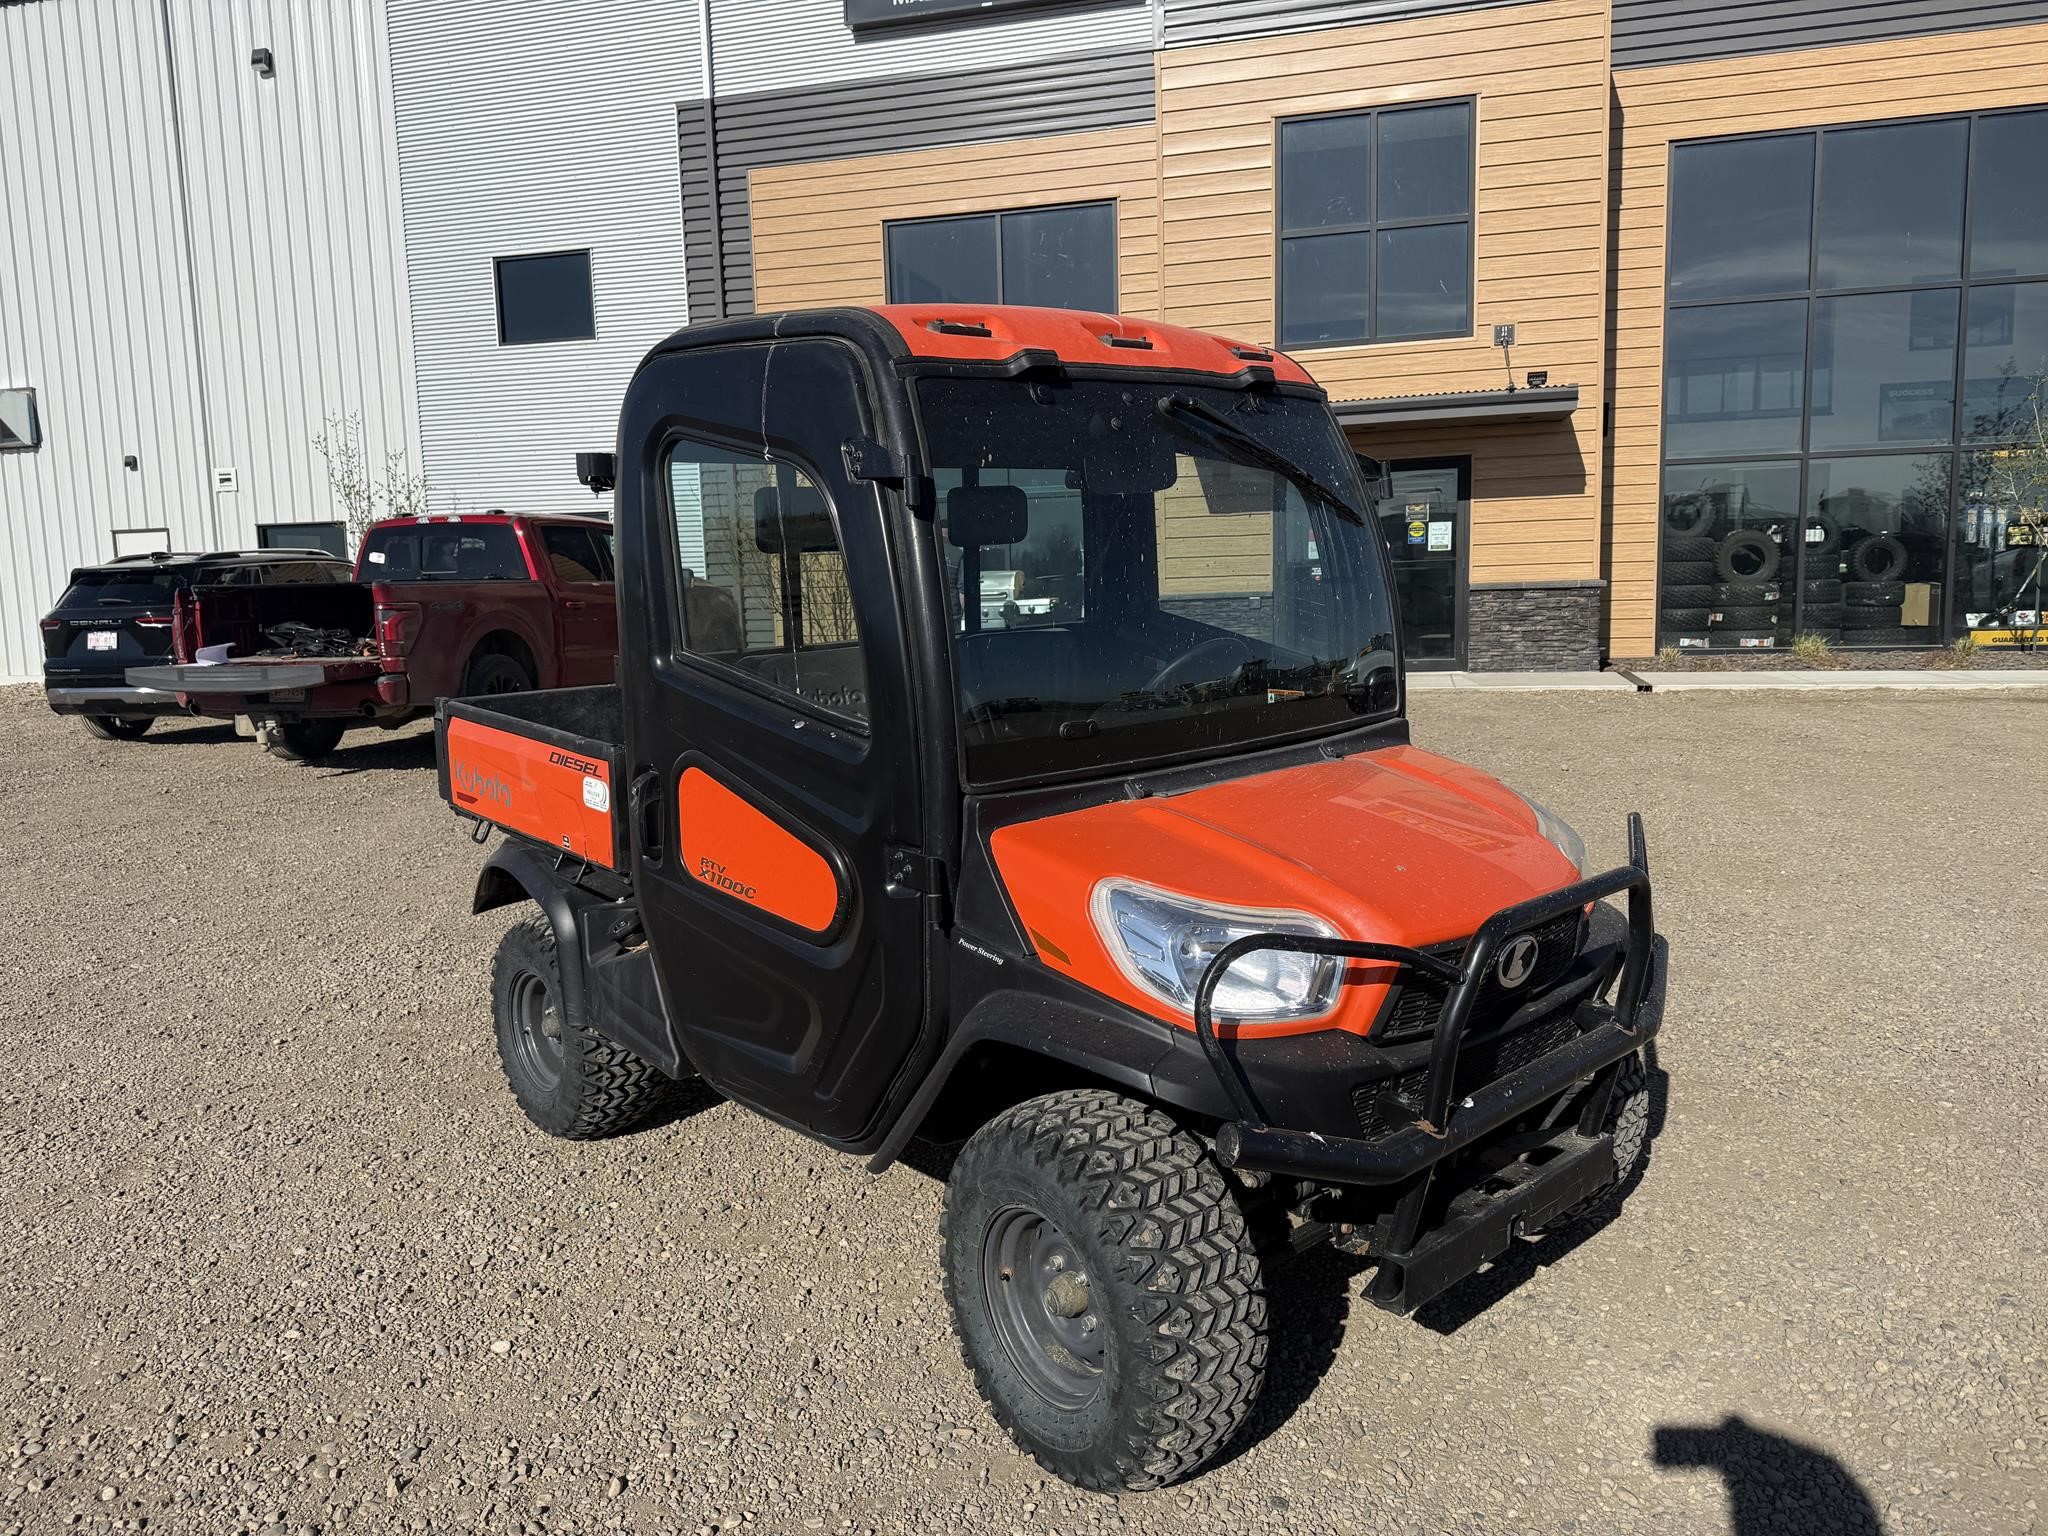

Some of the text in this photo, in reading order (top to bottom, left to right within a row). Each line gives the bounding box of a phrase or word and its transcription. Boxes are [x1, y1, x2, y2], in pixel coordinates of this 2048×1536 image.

[1991, 636, 2044, 644] GUARANTED
[549, 751, 602, 779] DIESEL
[454, 758, 511, 807] Kubota
[700, 857, 727, 874] RTV
[698, 867, 757, 899] X1100C
[958, 937, 1004, 966] Power Steering
